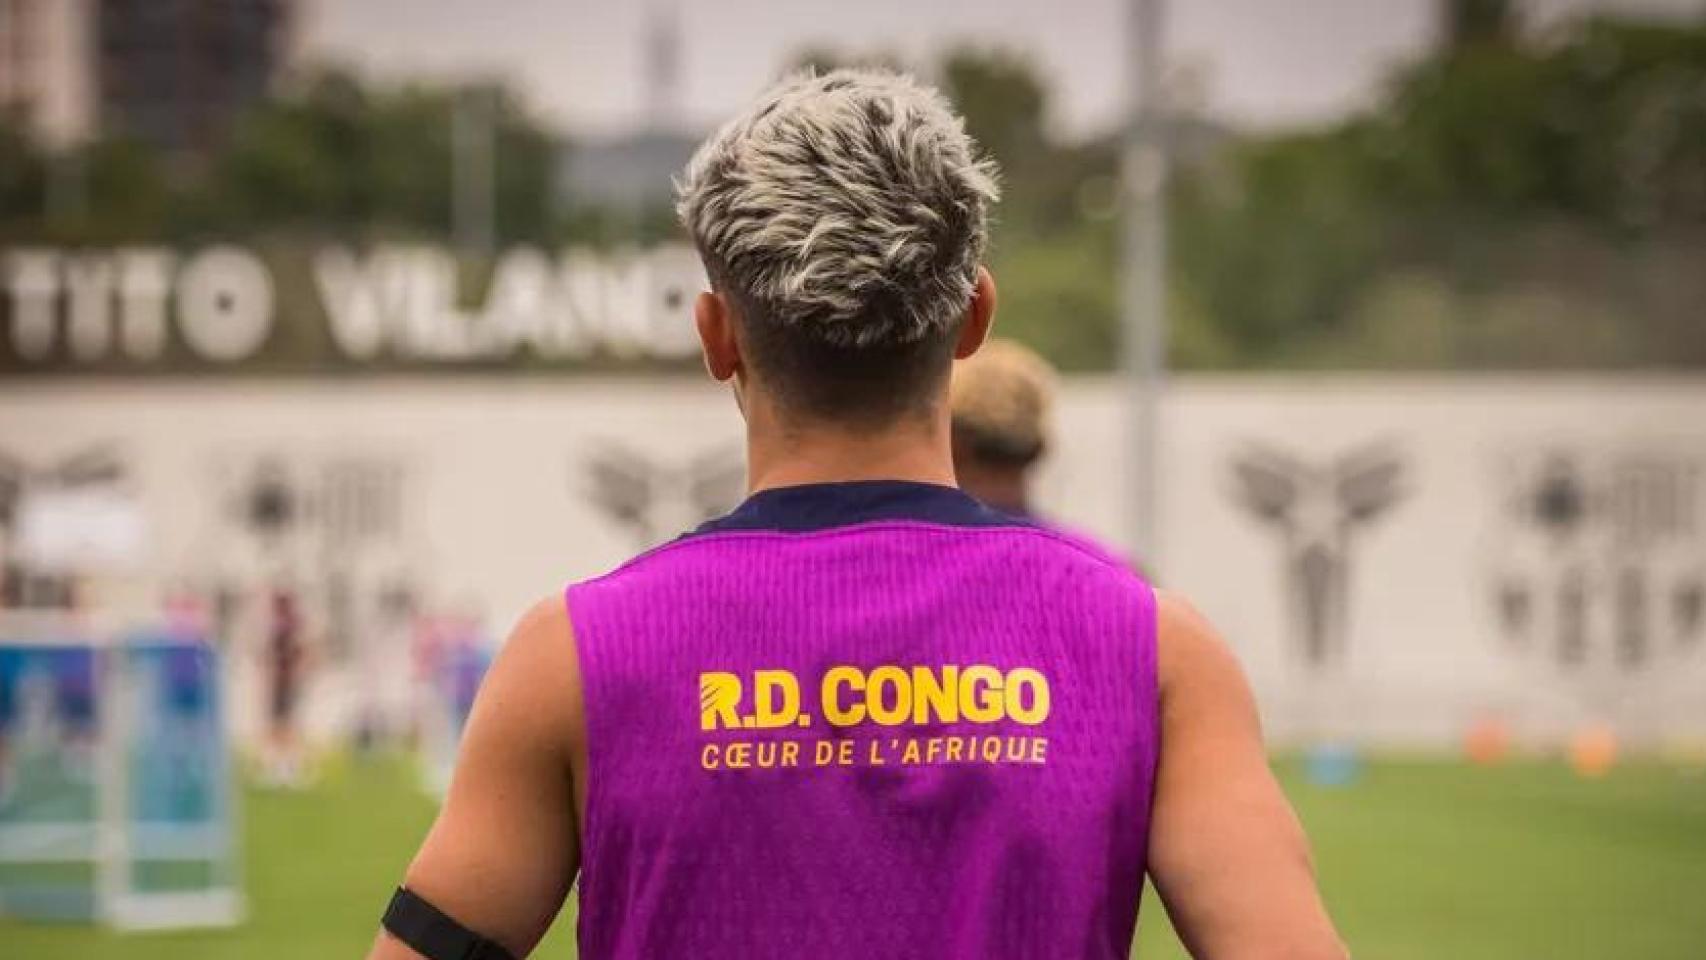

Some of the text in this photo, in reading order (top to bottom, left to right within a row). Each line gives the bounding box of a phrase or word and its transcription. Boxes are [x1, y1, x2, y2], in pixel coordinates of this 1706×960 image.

[700, 664, 1051, 730] R.D. CONGO
[701, 736, 1048, 769] CŒUR DE L’AFRIQUE
